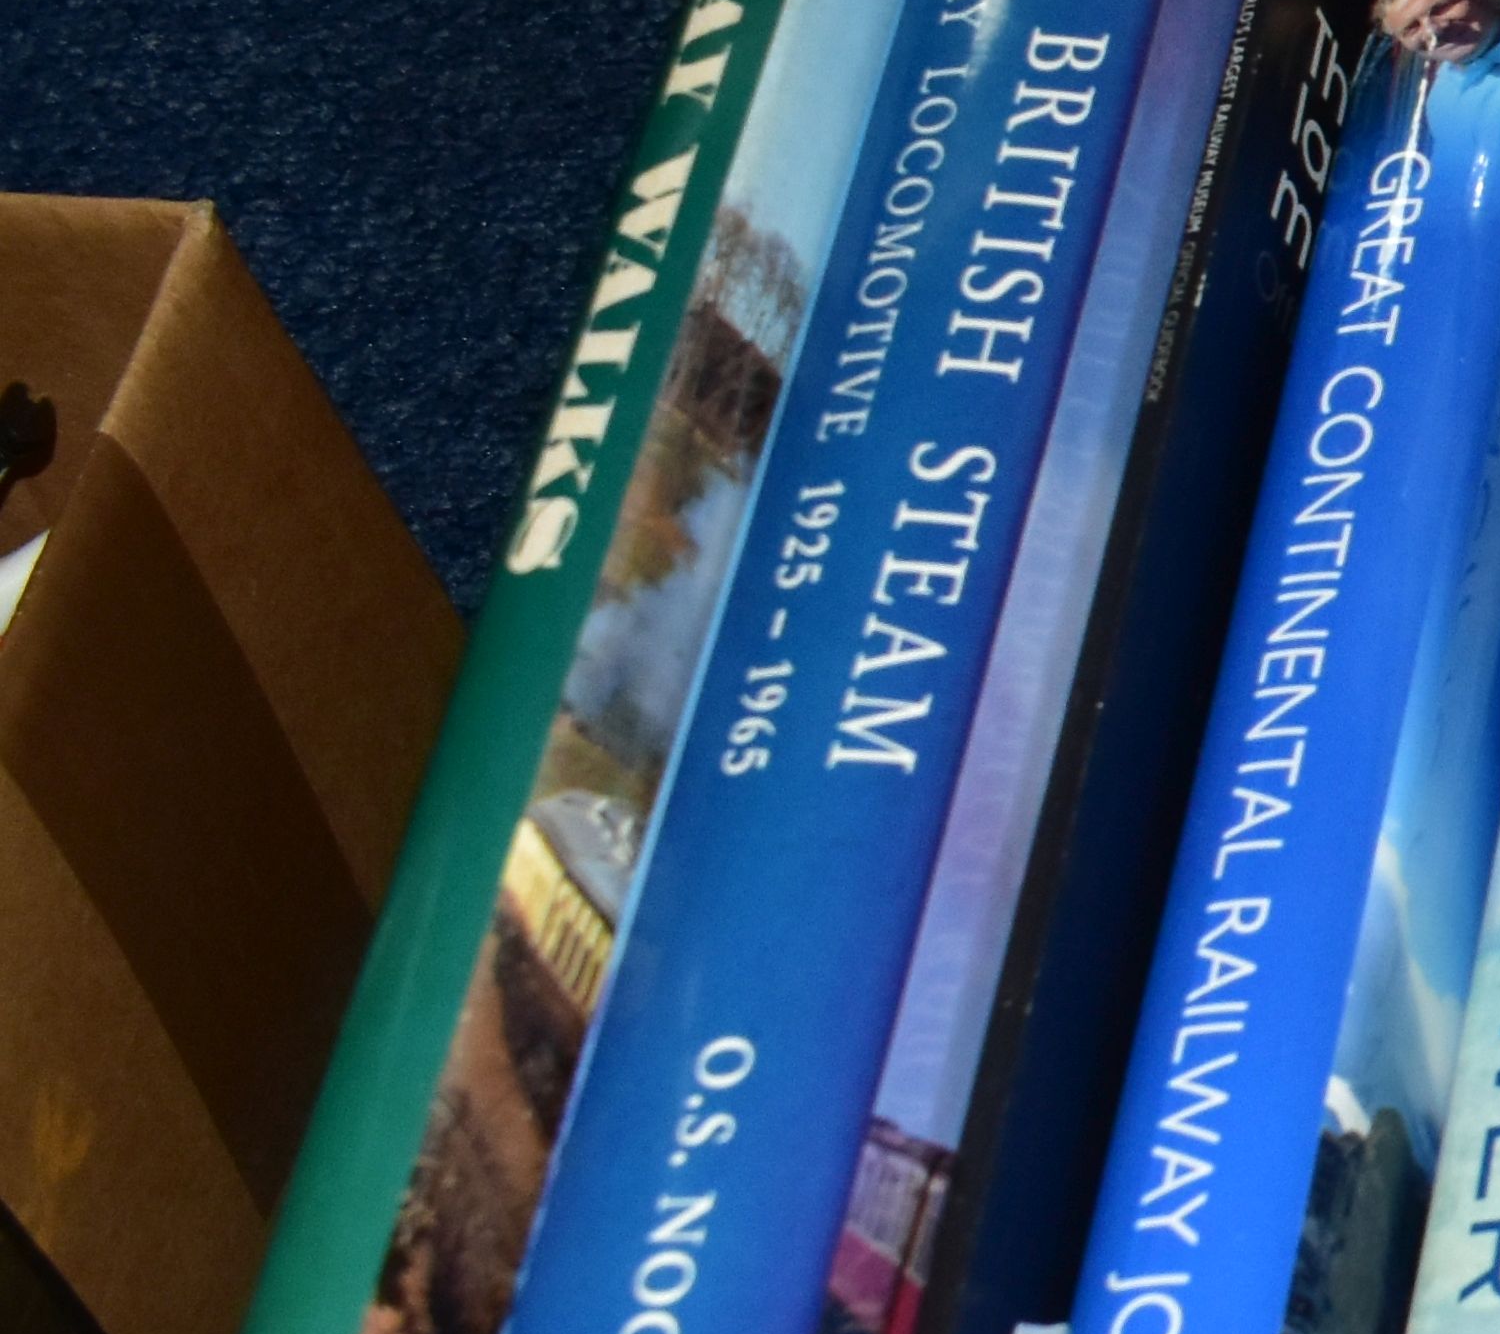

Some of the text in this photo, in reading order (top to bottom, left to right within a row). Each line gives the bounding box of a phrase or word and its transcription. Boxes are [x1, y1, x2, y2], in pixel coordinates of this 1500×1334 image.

[1201, 103, 1233, 167] RAILWAY
[1216, 37, 1248, 101] LARGEST
[816, 64, 971, 444] LOCOMOTIVE
[938, 26, 1111, 384] BRITISH
[1187, 169, 1216, 235] MUSEUM
[1340, 149, 1432, 347] GREAT
[506, 143, 700, 576] WALKS
[776, 480, 847, 592] 1925
[825, 441, 998, 776] STEAM
[1191, 365, 1383, 890] CONTINENTAL
[720, 660, 795, 778] 1965
[667, 1035, 757, 1168] O.S.
[1133, 894, 1273, 1250] RAILWAY
